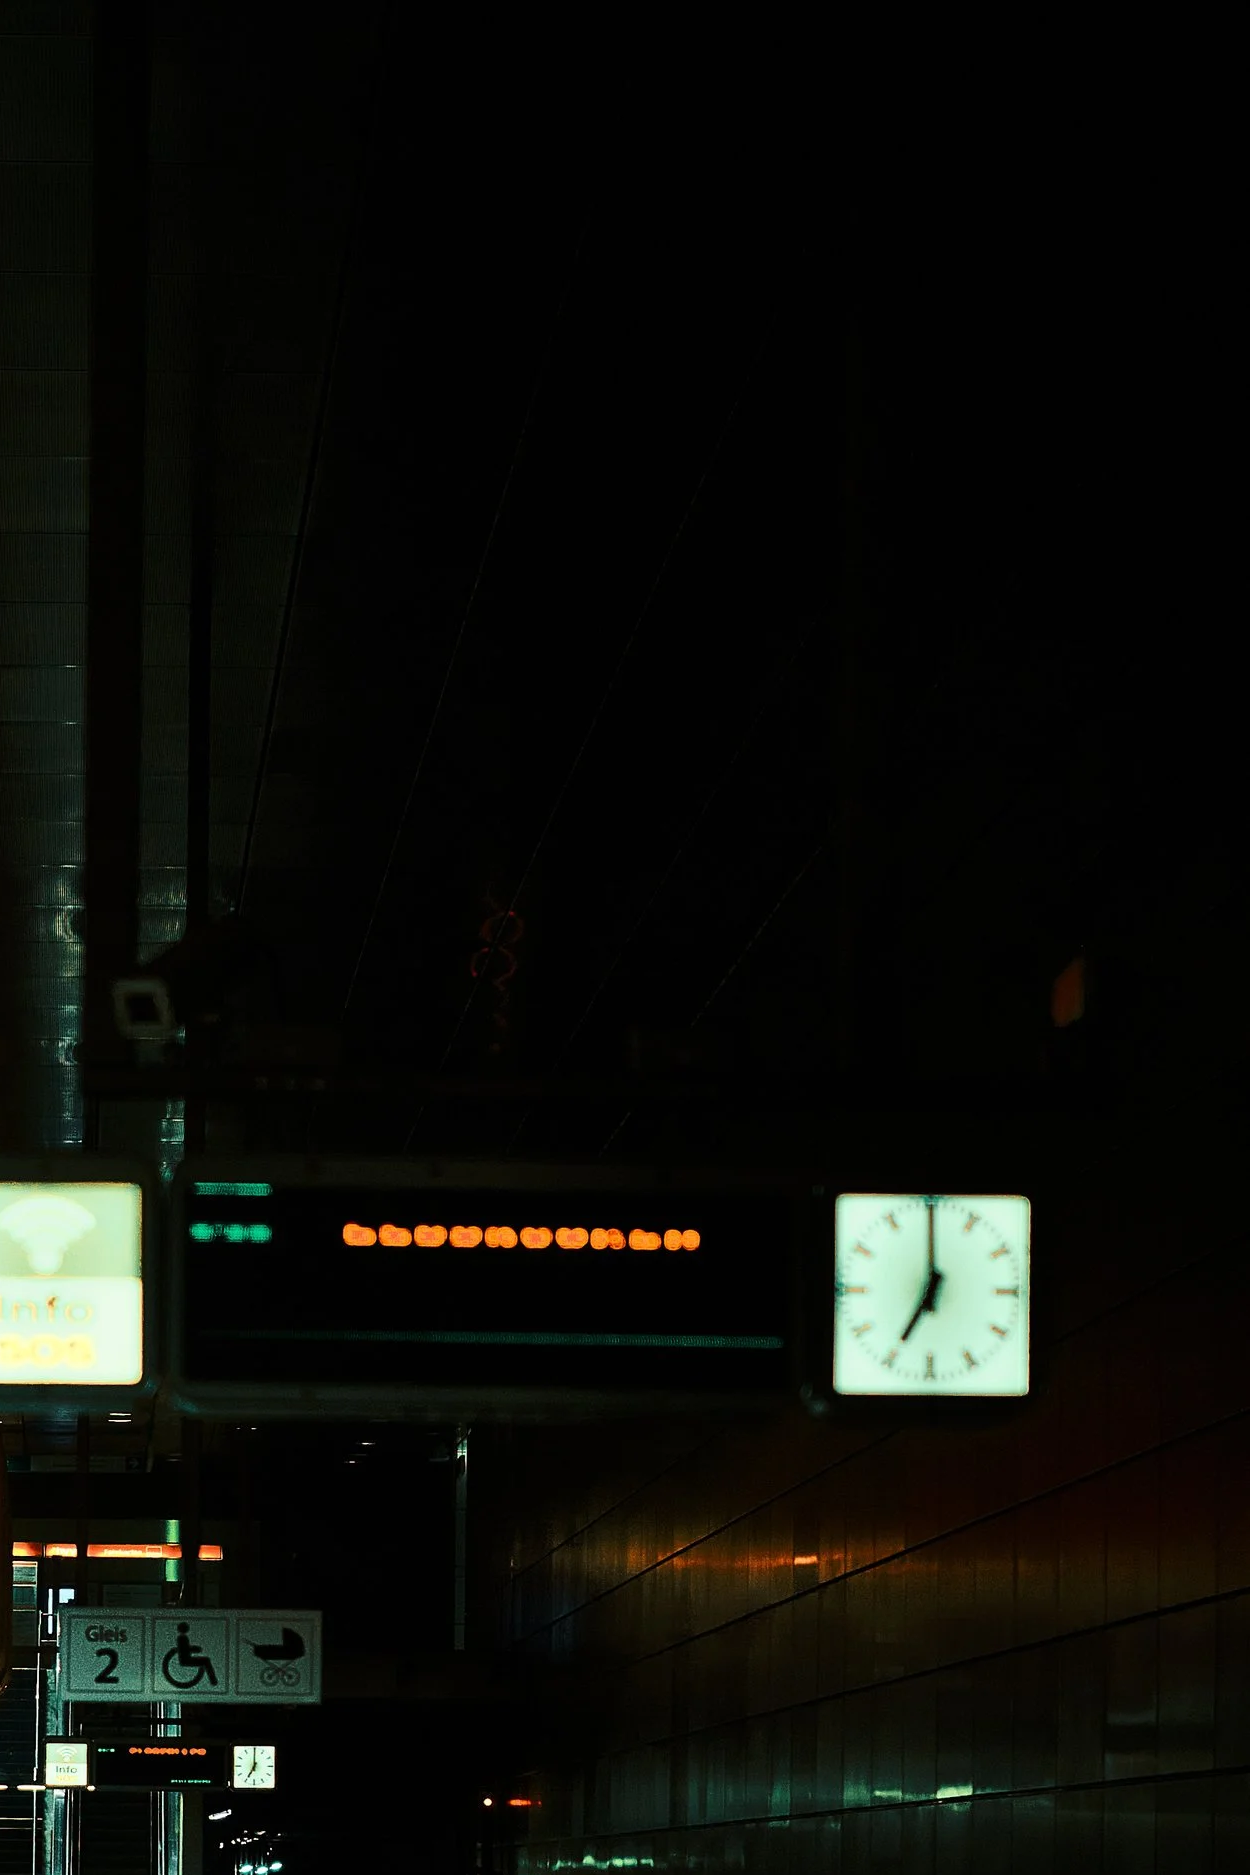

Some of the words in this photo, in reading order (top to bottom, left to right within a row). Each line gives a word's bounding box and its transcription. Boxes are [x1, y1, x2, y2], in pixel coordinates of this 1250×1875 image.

[85, 1624, 128, 1643] Gleis
[94, 1648, 120, 1684] 2
[55, 1765, 78, 1774] Info
